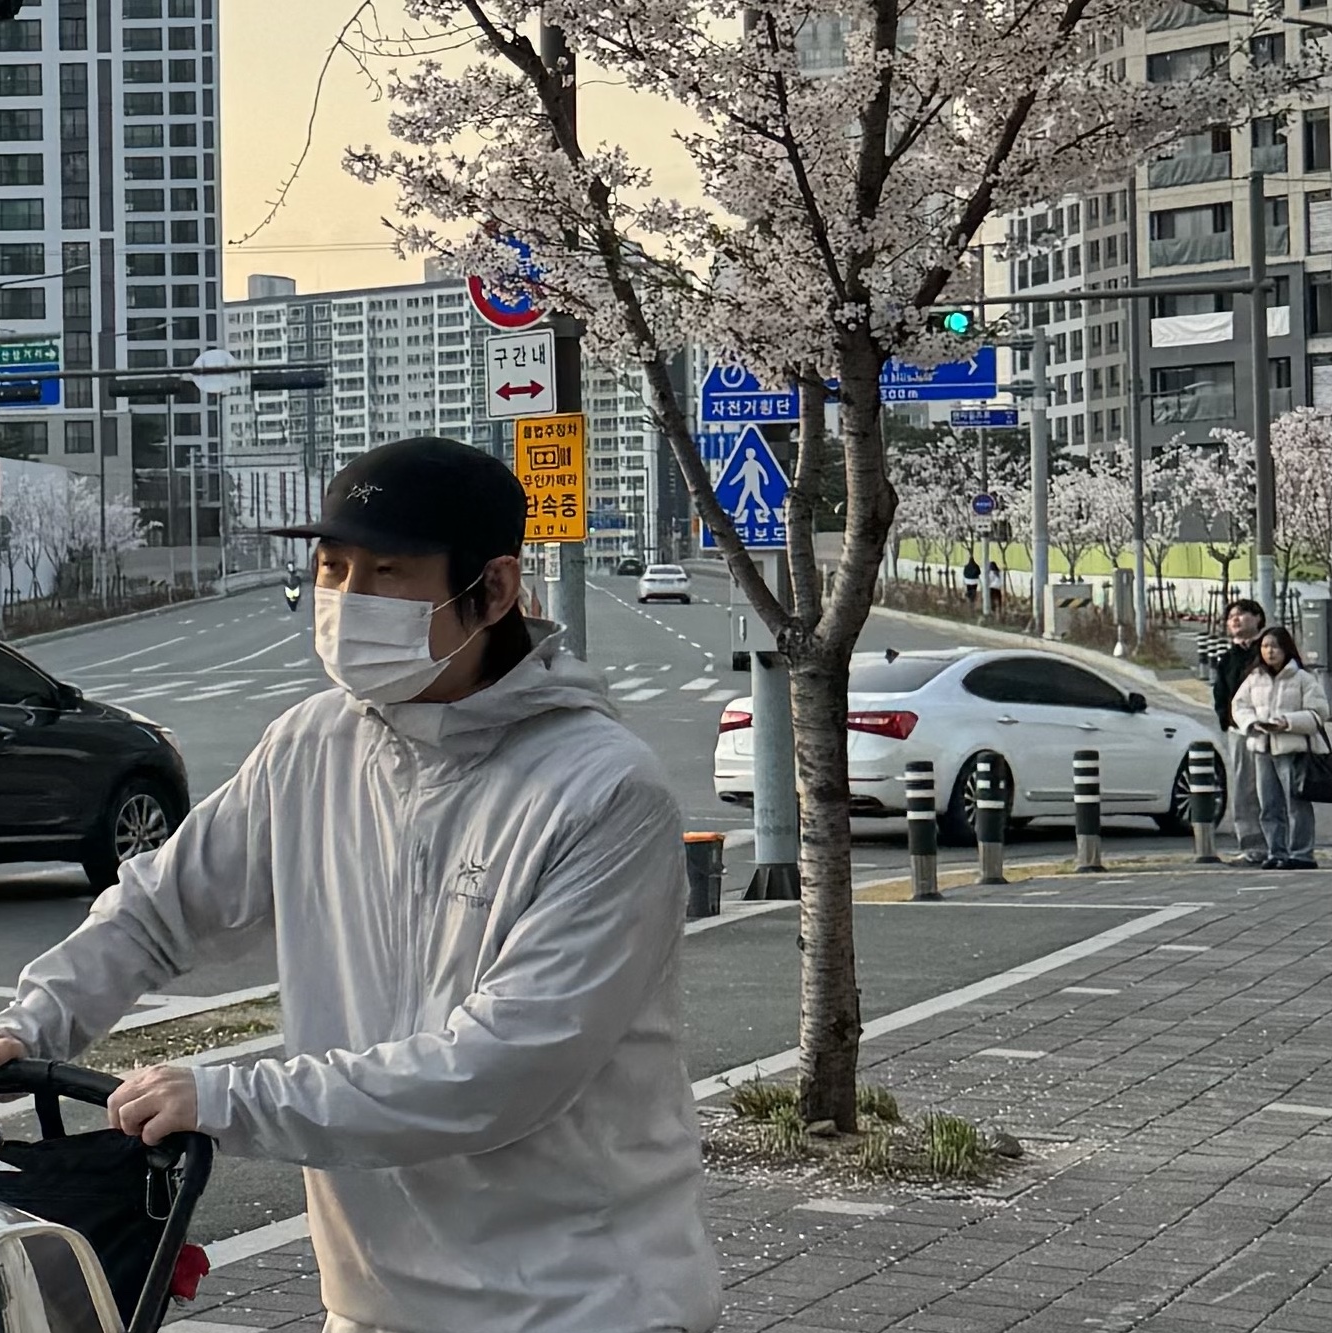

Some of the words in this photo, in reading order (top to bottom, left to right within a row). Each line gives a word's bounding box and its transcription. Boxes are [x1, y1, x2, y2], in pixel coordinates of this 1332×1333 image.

[494, 342, 546, 369] 구간내
[523, 425, 578, 440] 불법주정차
[522, 473, 578, 490] 무인카메라
[525, 493, 578, 519] 단속중
[734, 526, 786, 544] 단보도
